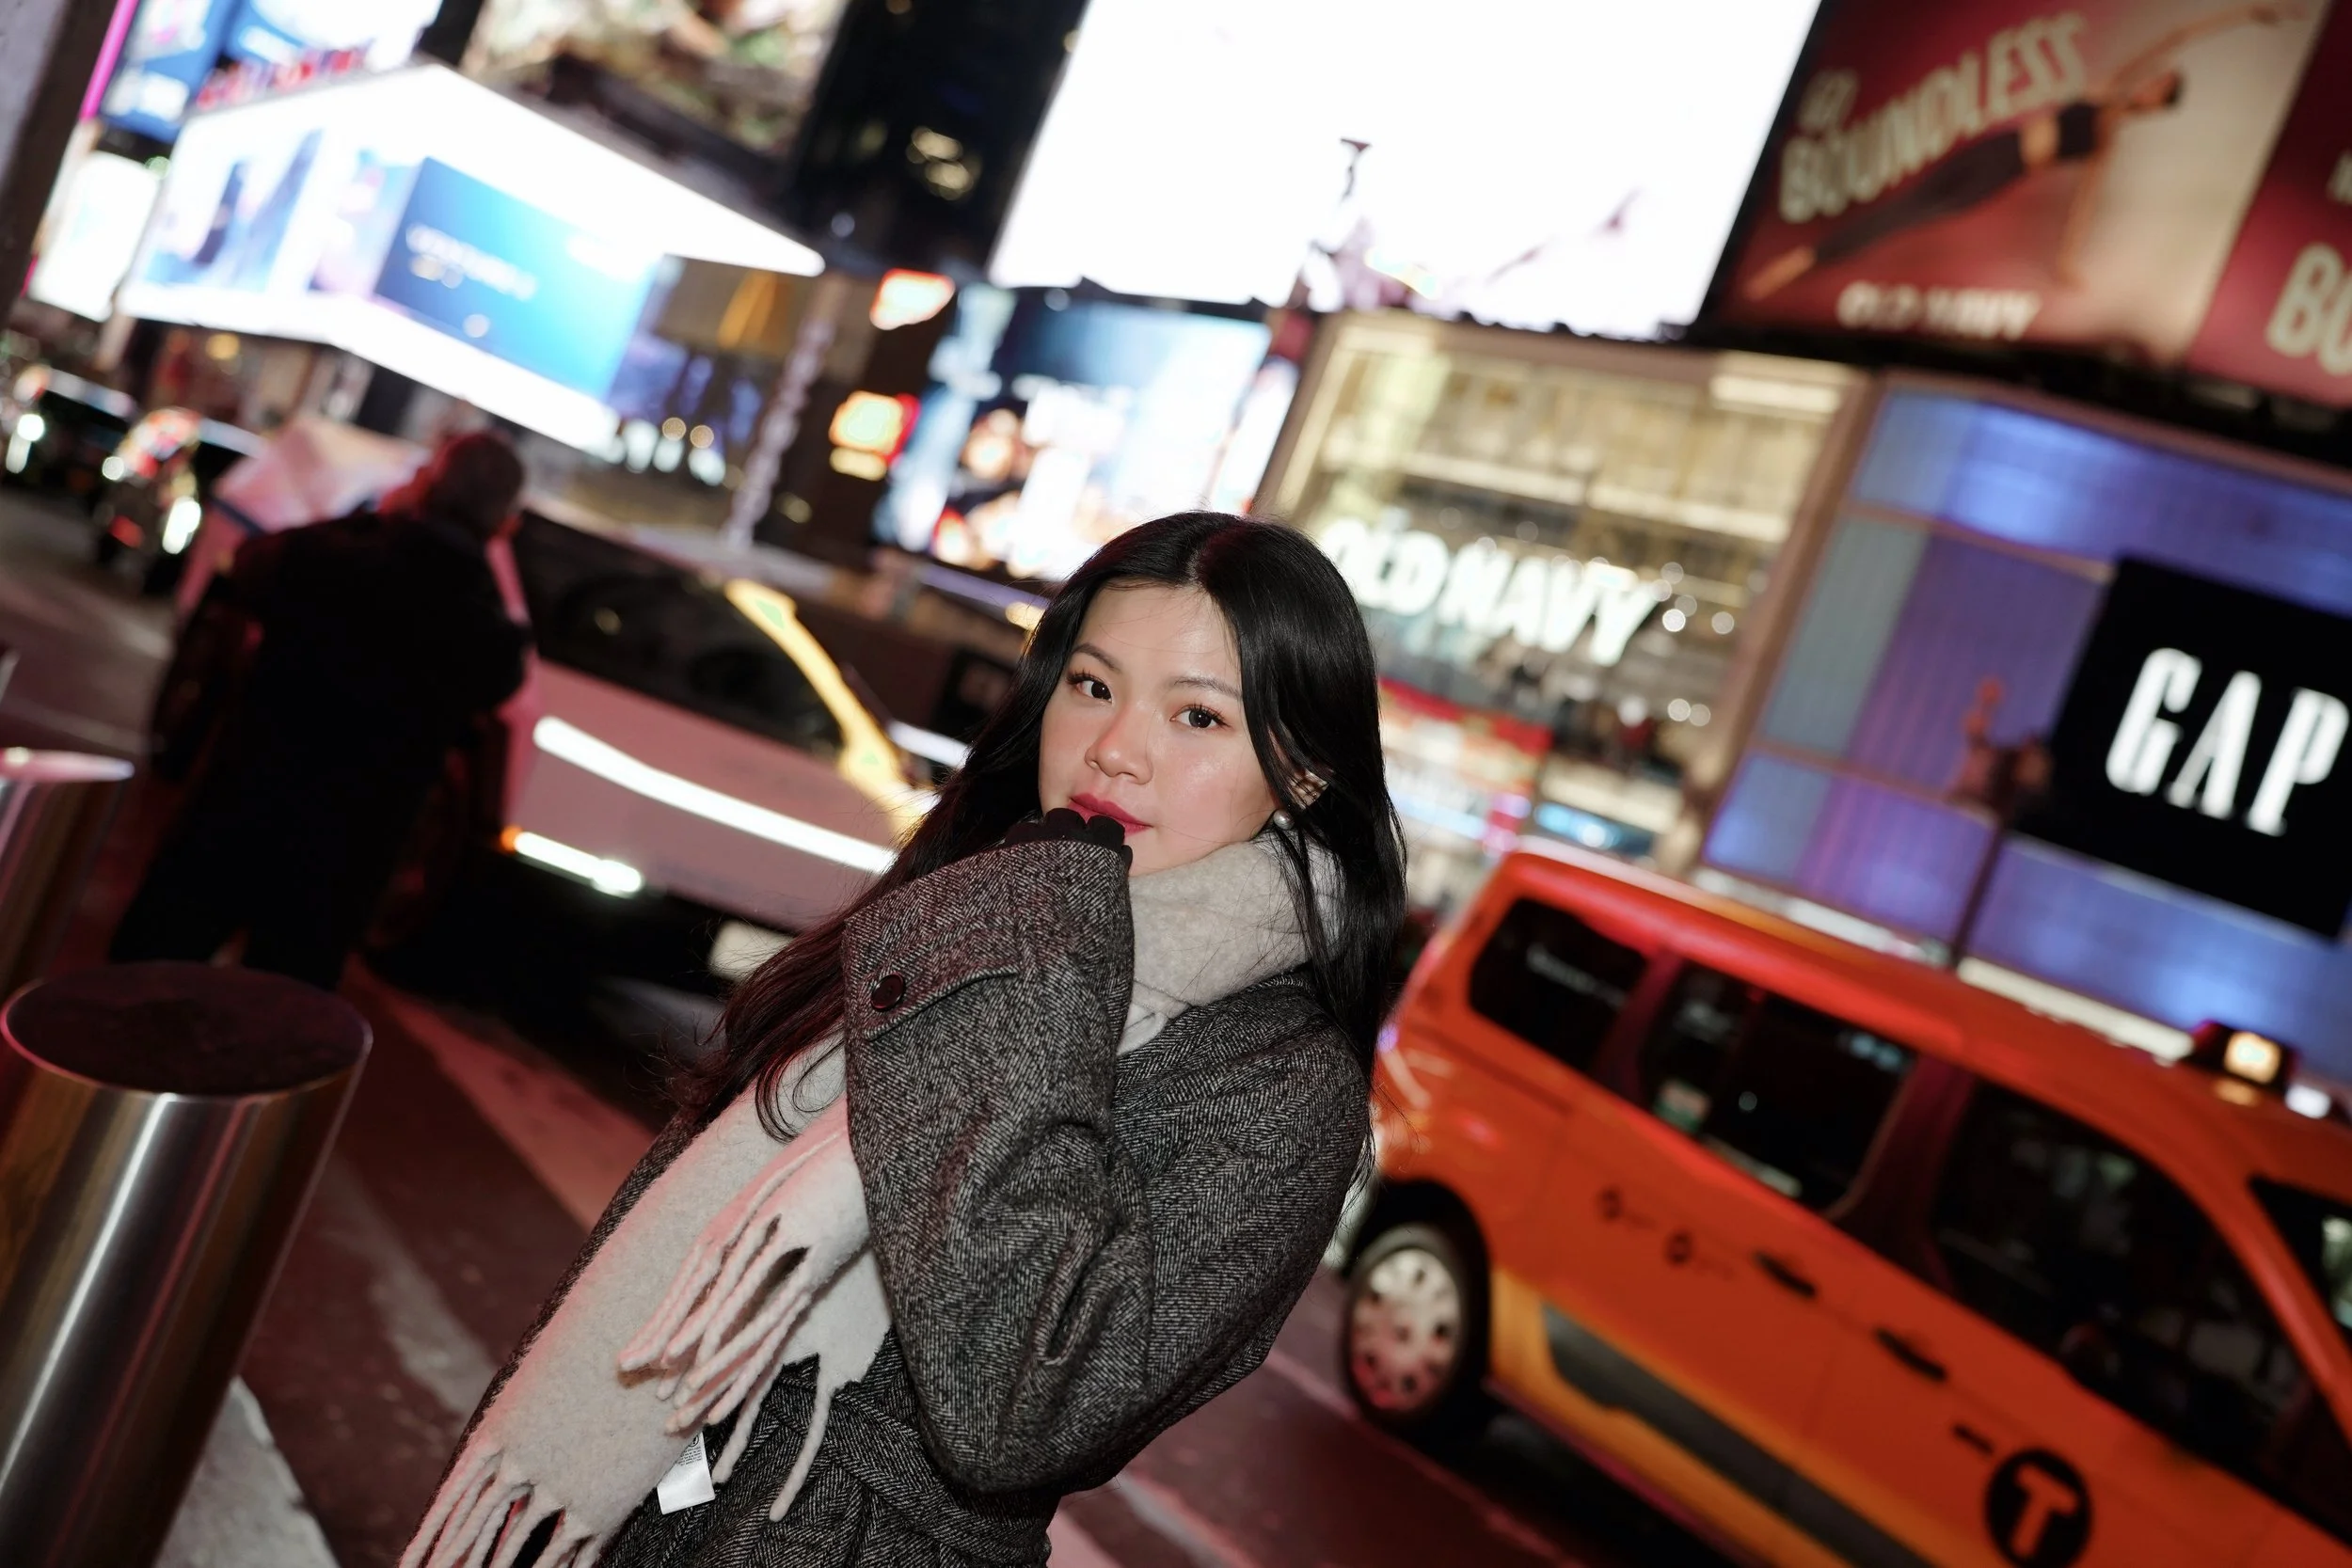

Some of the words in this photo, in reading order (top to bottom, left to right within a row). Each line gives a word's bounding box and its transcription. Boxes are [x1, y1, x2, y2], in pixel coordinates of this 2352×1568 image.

[1779, 10, 2088, 222] BOUNDLESS
[1313, 519, 1451, 617] OLD
[1436, 540, 1663, 666] NAVY
[2106, 647, 2349, 836] GAP
